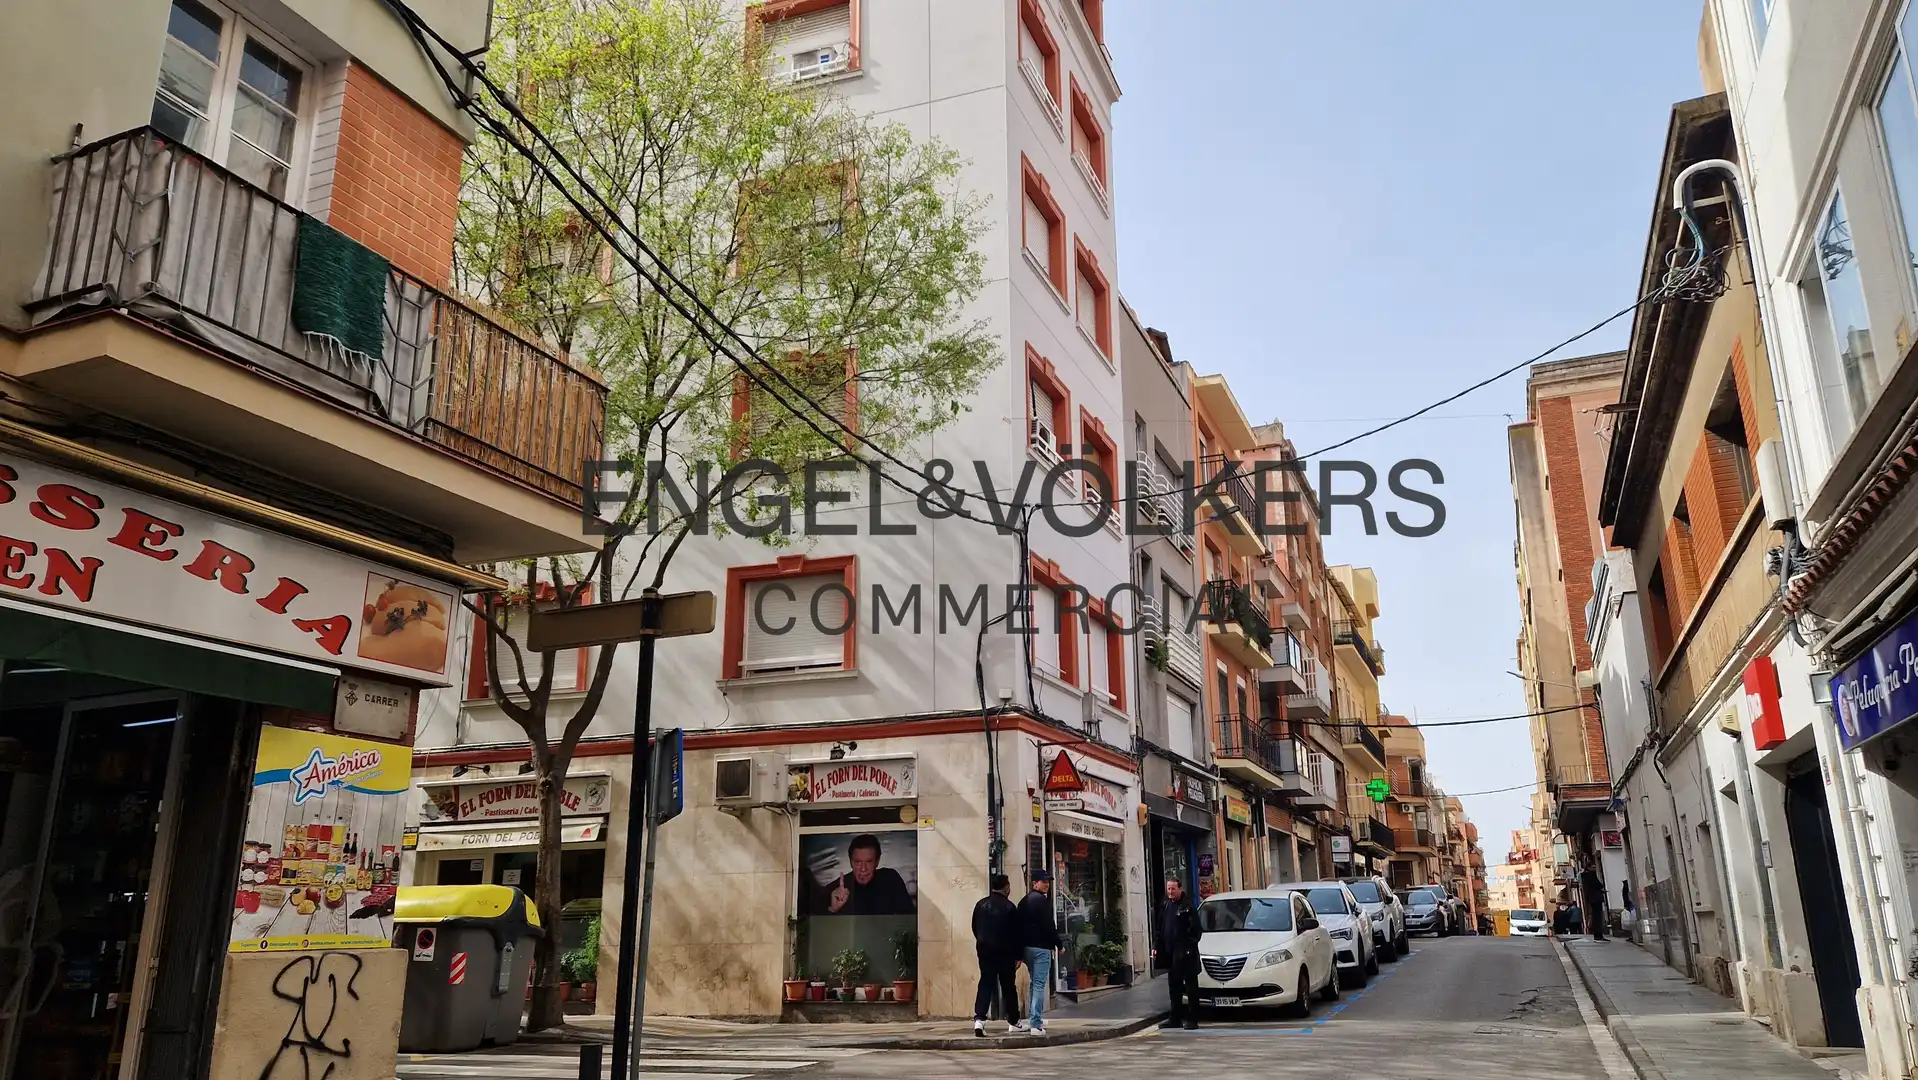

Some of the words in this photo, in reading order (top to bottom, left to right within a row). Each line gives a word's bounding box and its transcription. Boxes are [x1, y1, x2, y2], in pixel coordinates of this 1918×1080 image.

[0, 464, 353, 655] SERIA
[364, 692, 399, 708] CARRER
[303, 752, 380, 788] América
[815, 780, 827, 799] EL
[827, 765, 851, 789] FORN
[852, 765, 868, 781] DEL
[870, 767, 898, 795] POBLE
[1052, 775, 1074, 783] DELTA
[460, 800, 476, 818] EL
[479, 784, 513, 809] FORN
[514, 782, 538, 800] DEL
[484, 808, 519, 816] Pastisseria
[461, 834, 490, 845] FORN
[495, 833, 513, 843] DEL
[519, 831, 540, 841] POB
[1071, 823, 1083, 834] FORN
[1083, 824, 1091, 835] DEL
[1092, 826, 1104, 838] POBLE
